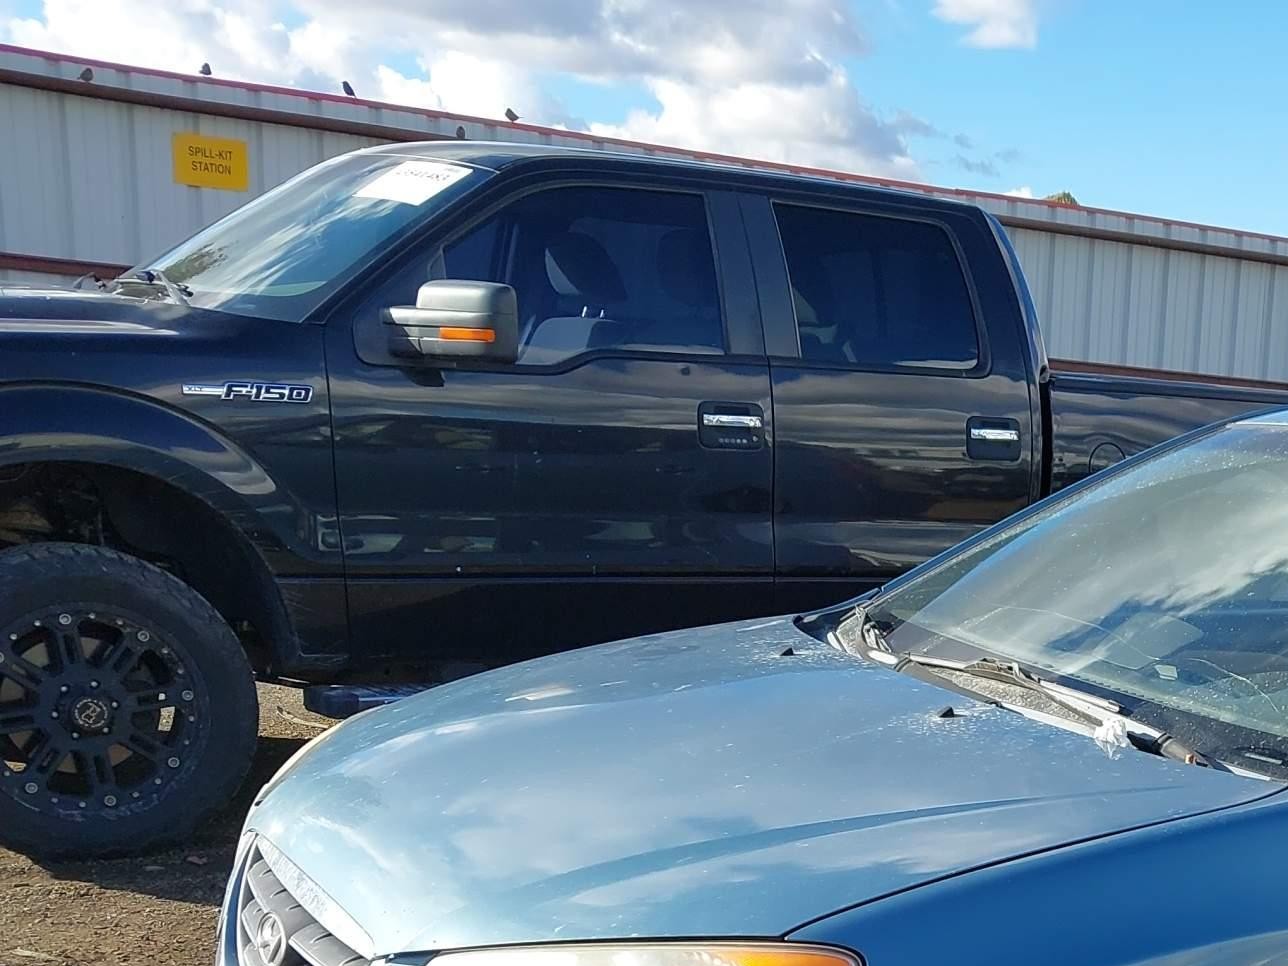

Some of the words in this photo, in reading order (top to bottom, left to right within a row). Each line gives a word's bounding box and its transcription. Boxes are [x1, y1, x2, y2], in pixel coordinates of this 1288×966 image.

[187, 145, 233, 161] SPILL-KIT
[191, 160, 232, 176] STATION
[221, 382, 313, 403] F-150
